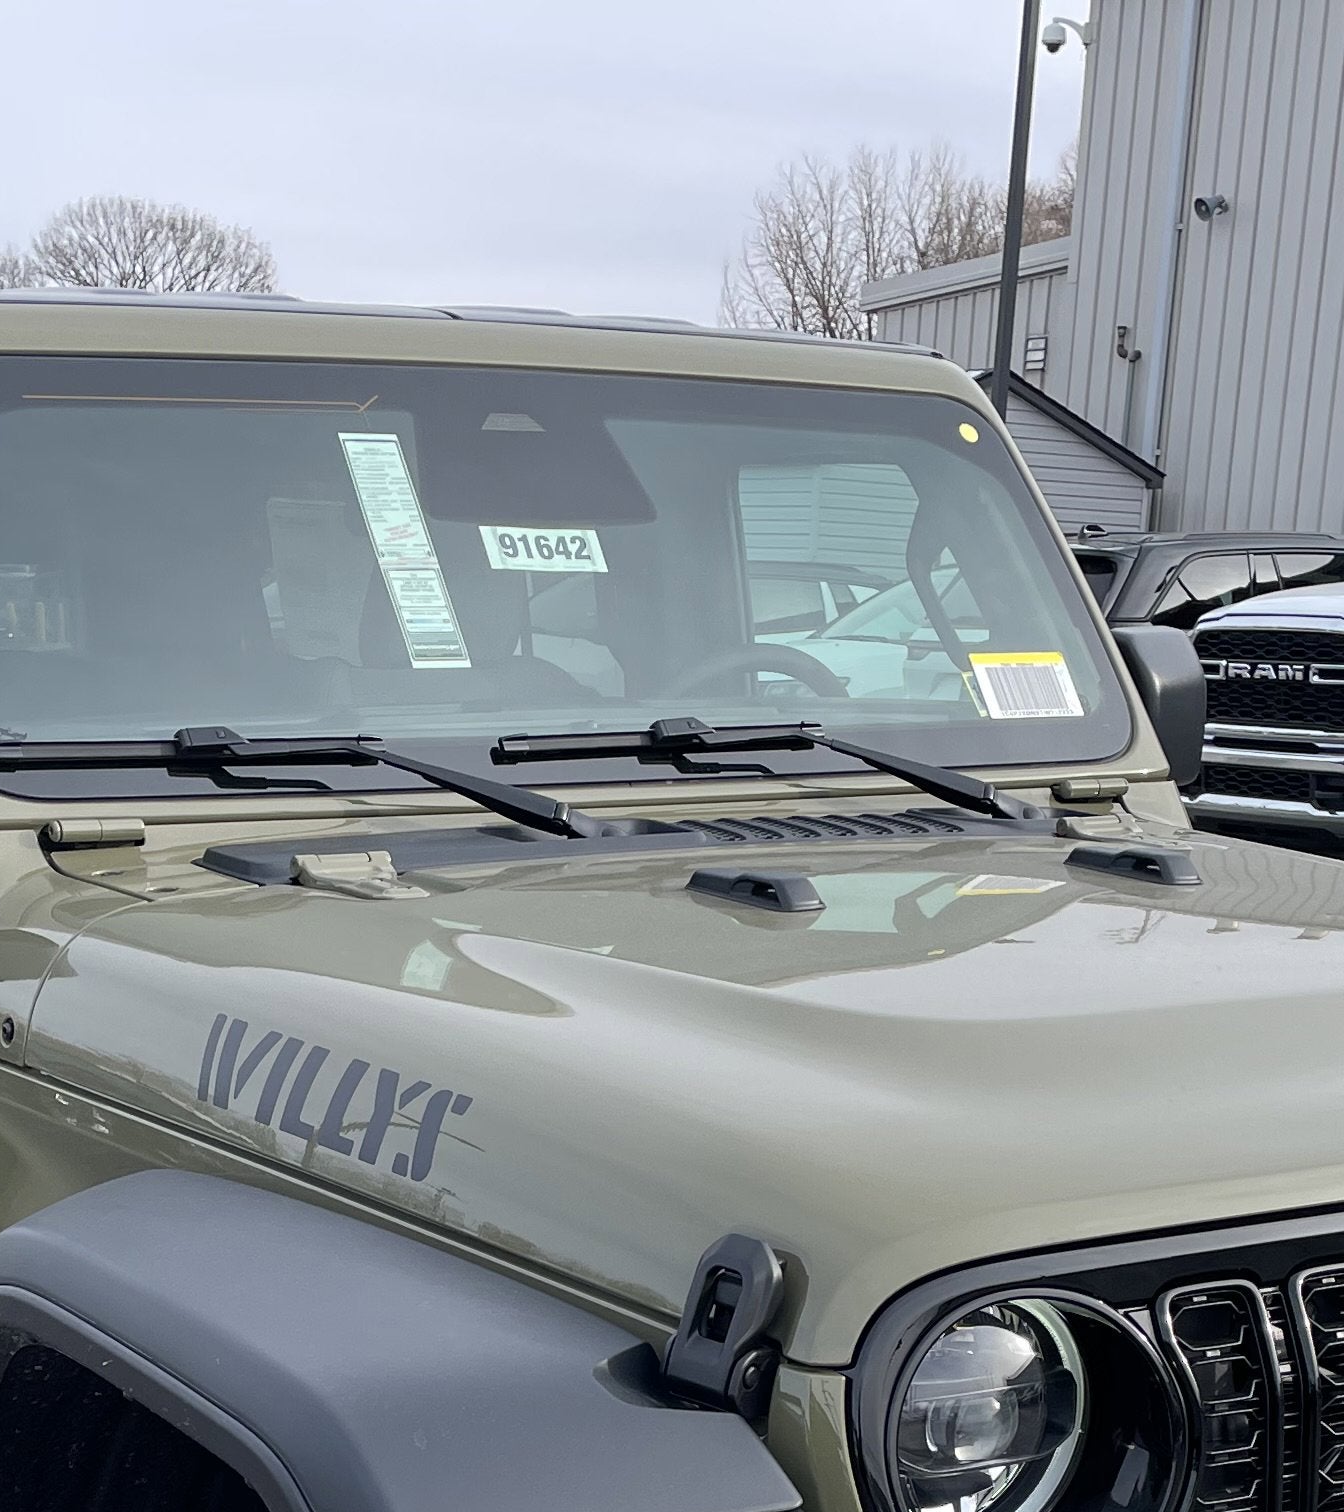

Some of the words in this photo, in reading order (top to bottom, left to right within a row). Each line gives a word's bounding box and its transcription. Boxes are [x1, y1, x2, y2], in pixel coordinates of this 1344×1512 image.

[498, 532, 592, 560] 91642
[1227, 662, 1305, 681] RAM
[197, 1012, 473, 1182] WILLYS
